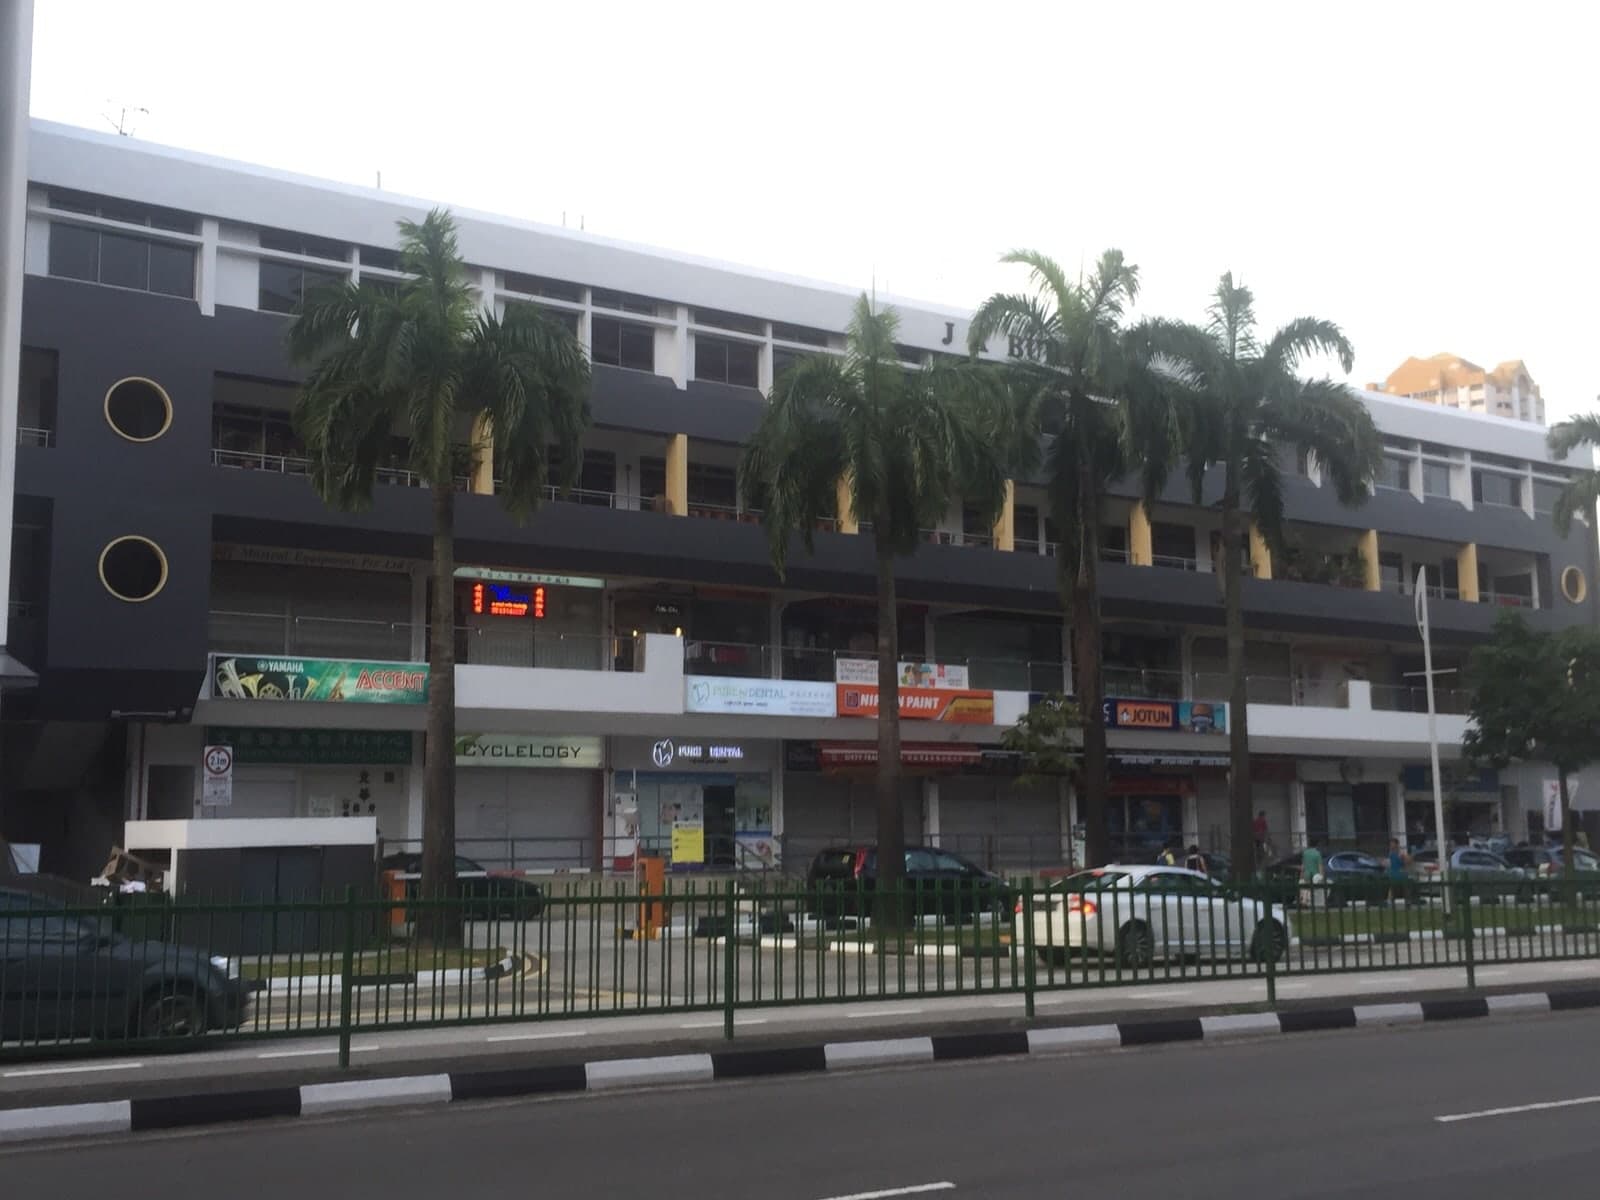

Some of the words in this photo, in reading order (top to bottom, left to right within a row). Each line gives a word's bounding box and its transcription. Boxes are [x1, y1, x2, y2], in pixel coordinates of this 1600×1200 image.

[942, 321, 955, 345] J
[268, 661, 304, 673] YAMAHA
[356, 669, 426, 690] ACCENT
[748, 688, 785, 700] DENTAL
[861, 693, 905, 708] NIPN
[906, 696, 940, 710] PAINT
[1132, 708, 1170, 724] JOTUN
[463, 744, 582, 759] CYCLELOGY
[210, 755, 228, 767] 2.1m
